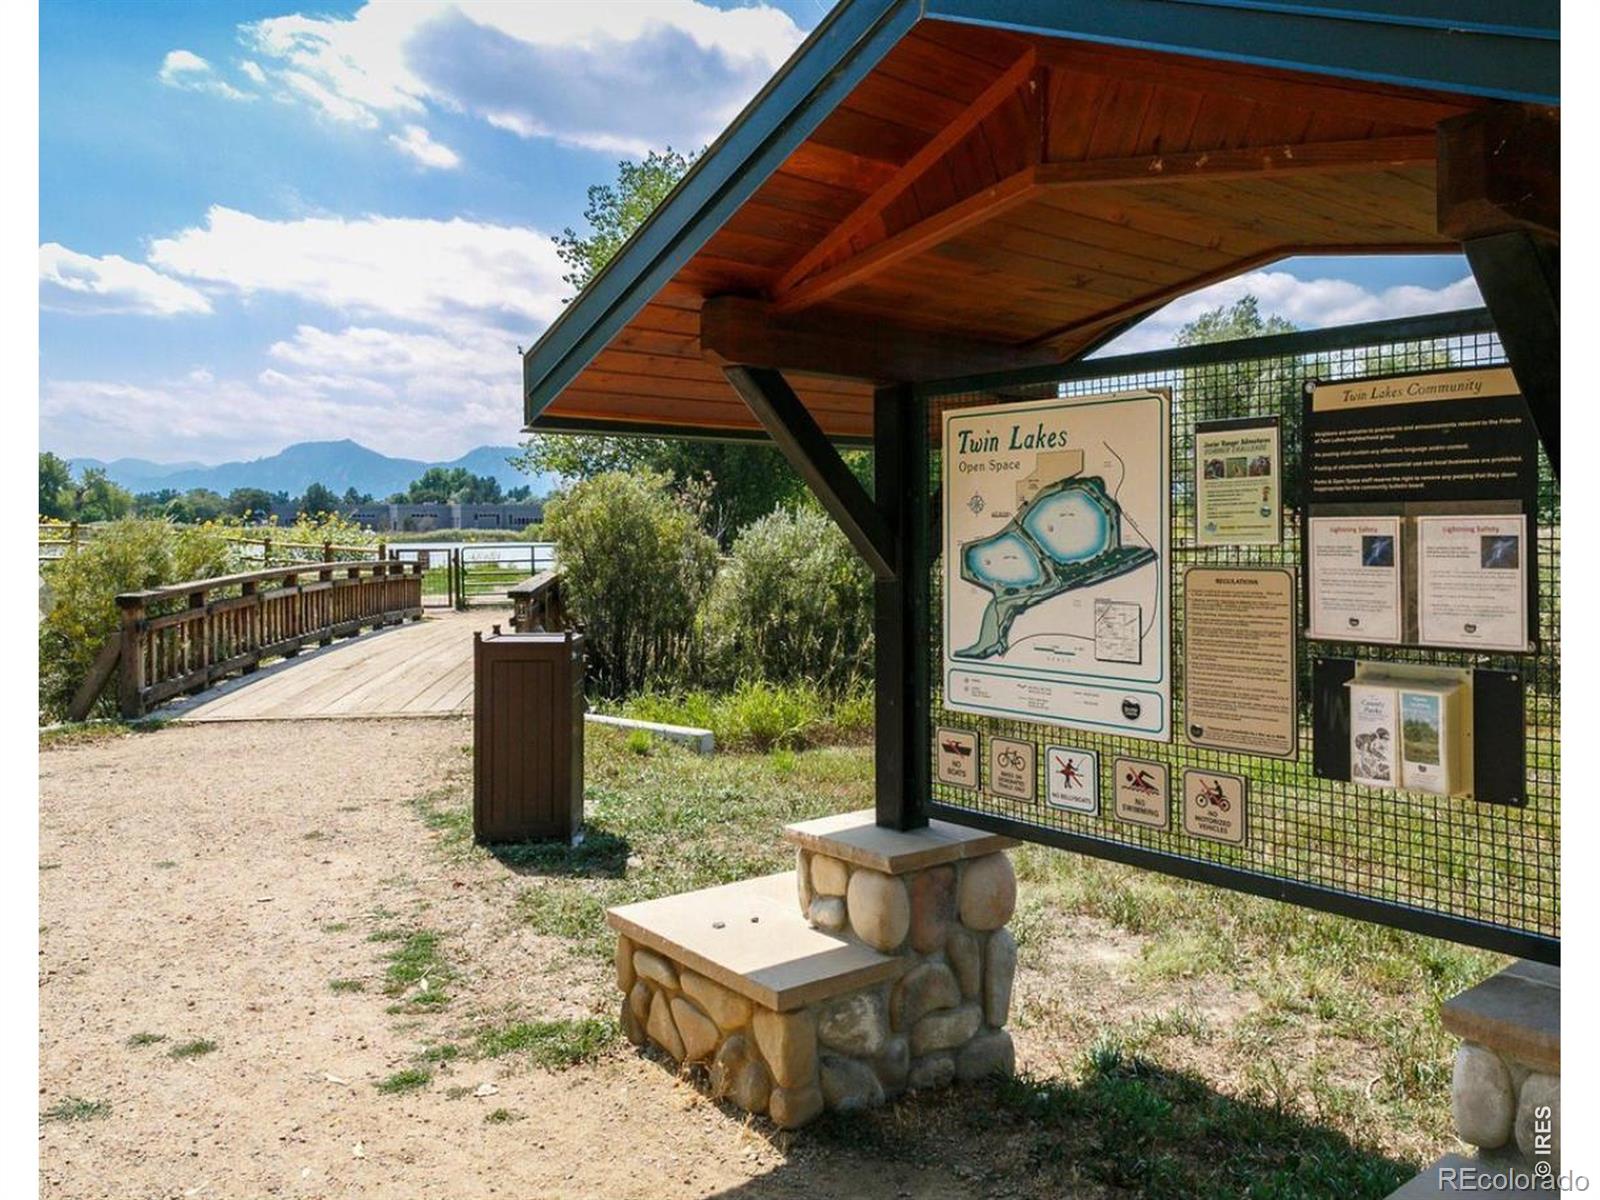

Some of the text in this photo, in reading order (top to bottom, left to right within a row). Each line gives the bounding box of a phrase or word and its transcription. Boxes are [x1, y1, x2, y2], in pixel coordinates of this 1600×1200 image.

[1343, 380, 1482, 402] Twin Lakes Community
[958, 423, 1068, 454] Twin Lakes
[958, 459, 1020, 473] Open Space
[947, 768, 967, 778] BOATS
[1122, 804, 1159, 817] SWIMMING
[1195, 815, 1231, 827] MOTORIZED
[1199, 823, 1228, 834] VEHICLES
